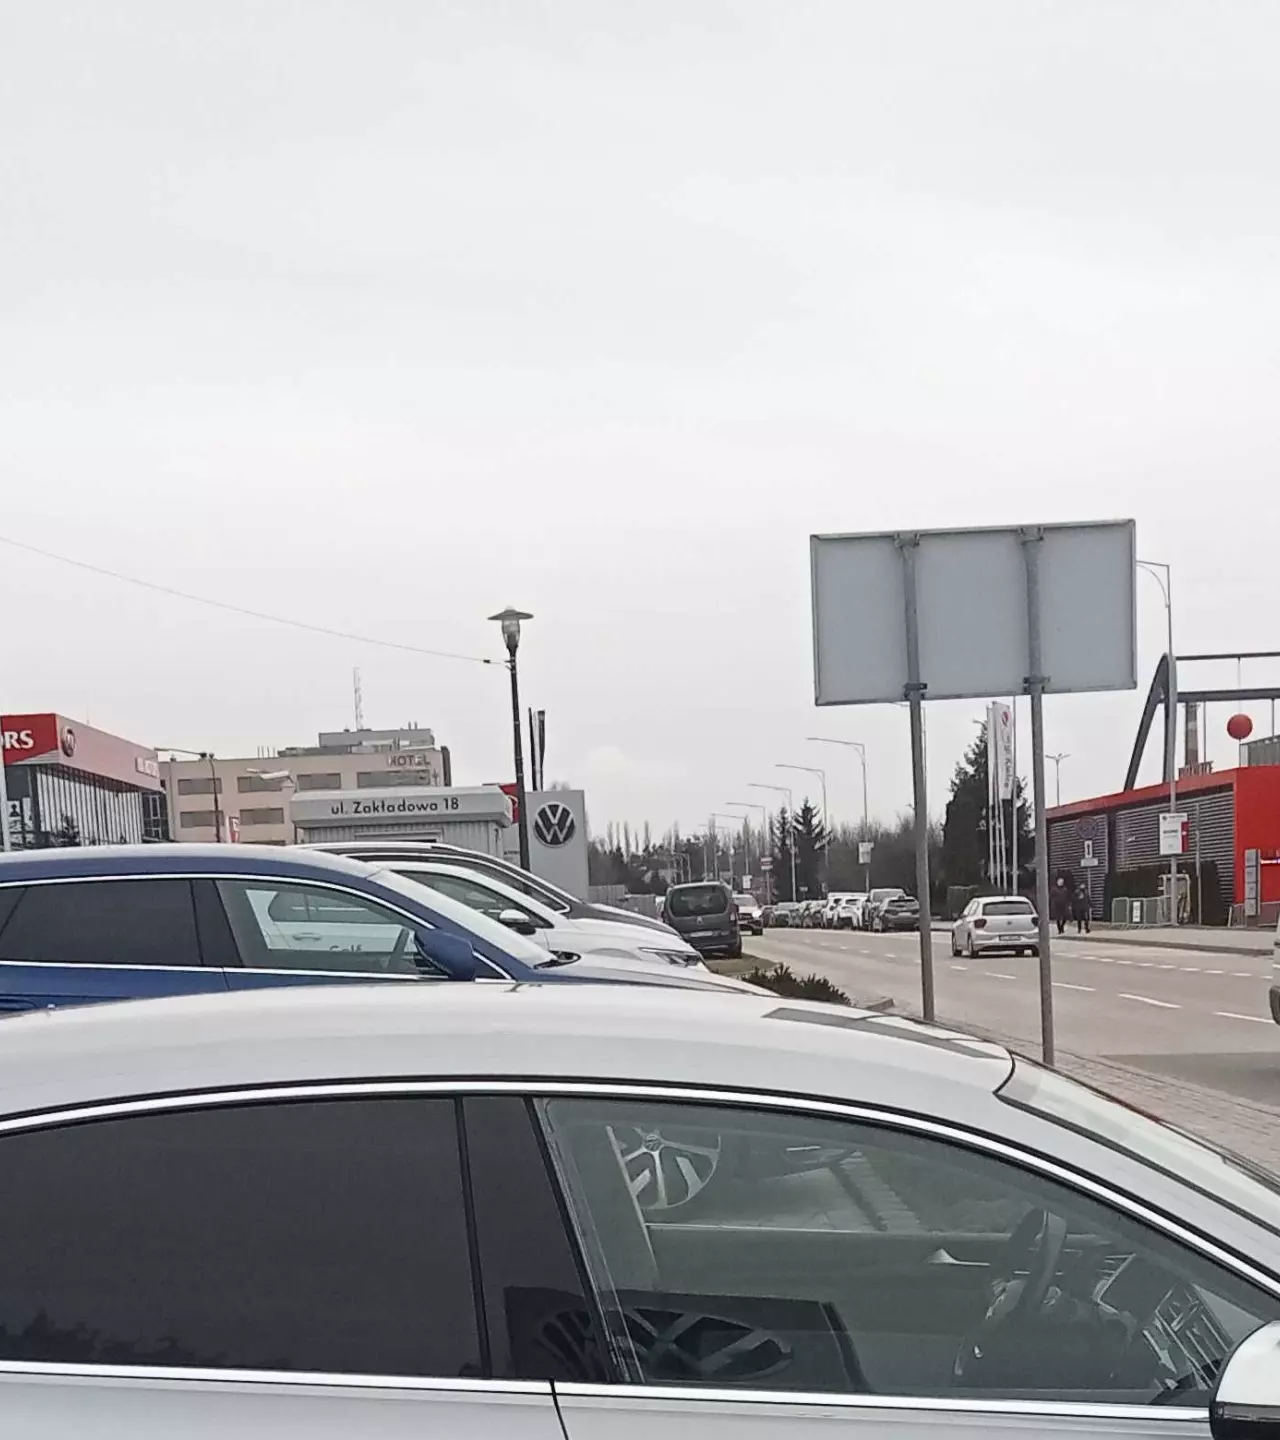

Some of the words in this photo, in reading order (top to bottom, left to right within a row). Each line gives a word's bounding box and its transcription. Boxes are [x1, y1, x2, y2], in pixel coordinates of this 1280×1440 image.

[331, 801, 348, 815] ul.
[352, 799, 439, 815] Zakładowa
[444, 798, 460, 811] 18
